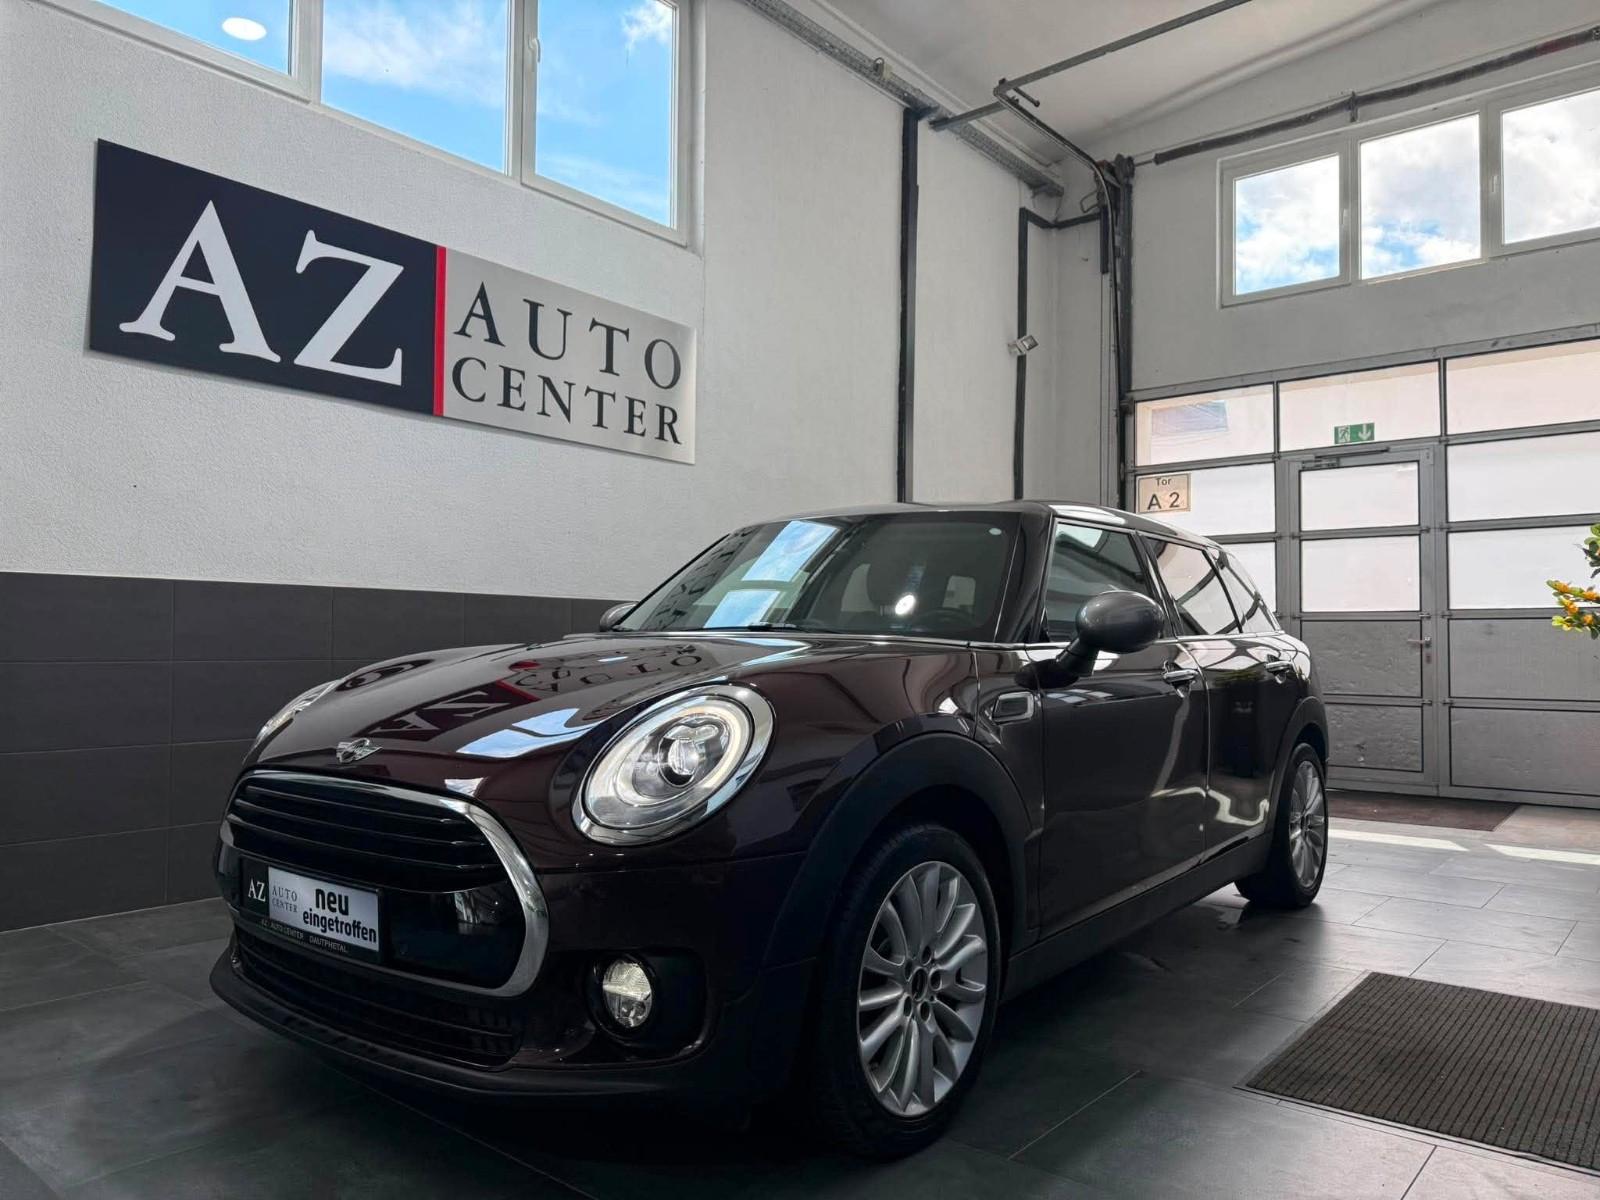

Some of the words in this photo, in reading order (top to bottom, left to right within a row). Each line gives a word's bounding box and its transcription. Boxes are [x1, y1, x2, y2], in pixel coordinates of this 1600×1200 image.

[119, 200, 404, 386] AZ
[453, 281, 681, 390] AUTO
[451, 356, 682, 445] CENTER
[1156, 477, 1172, 486] Tor
[1147, 494, 1162, 510] A
[1169, 492, 1180, 508] 2
[248, 879, 266, 902] AZ
[272, 885, 298, 902] AUTO
[315, 888, 349, 916] neu
[272, 898, 298, 913] CENTER
[303, 909, 377, 943] eingetroffen
[309, 935, 347, 953] DAUTPHETAL
